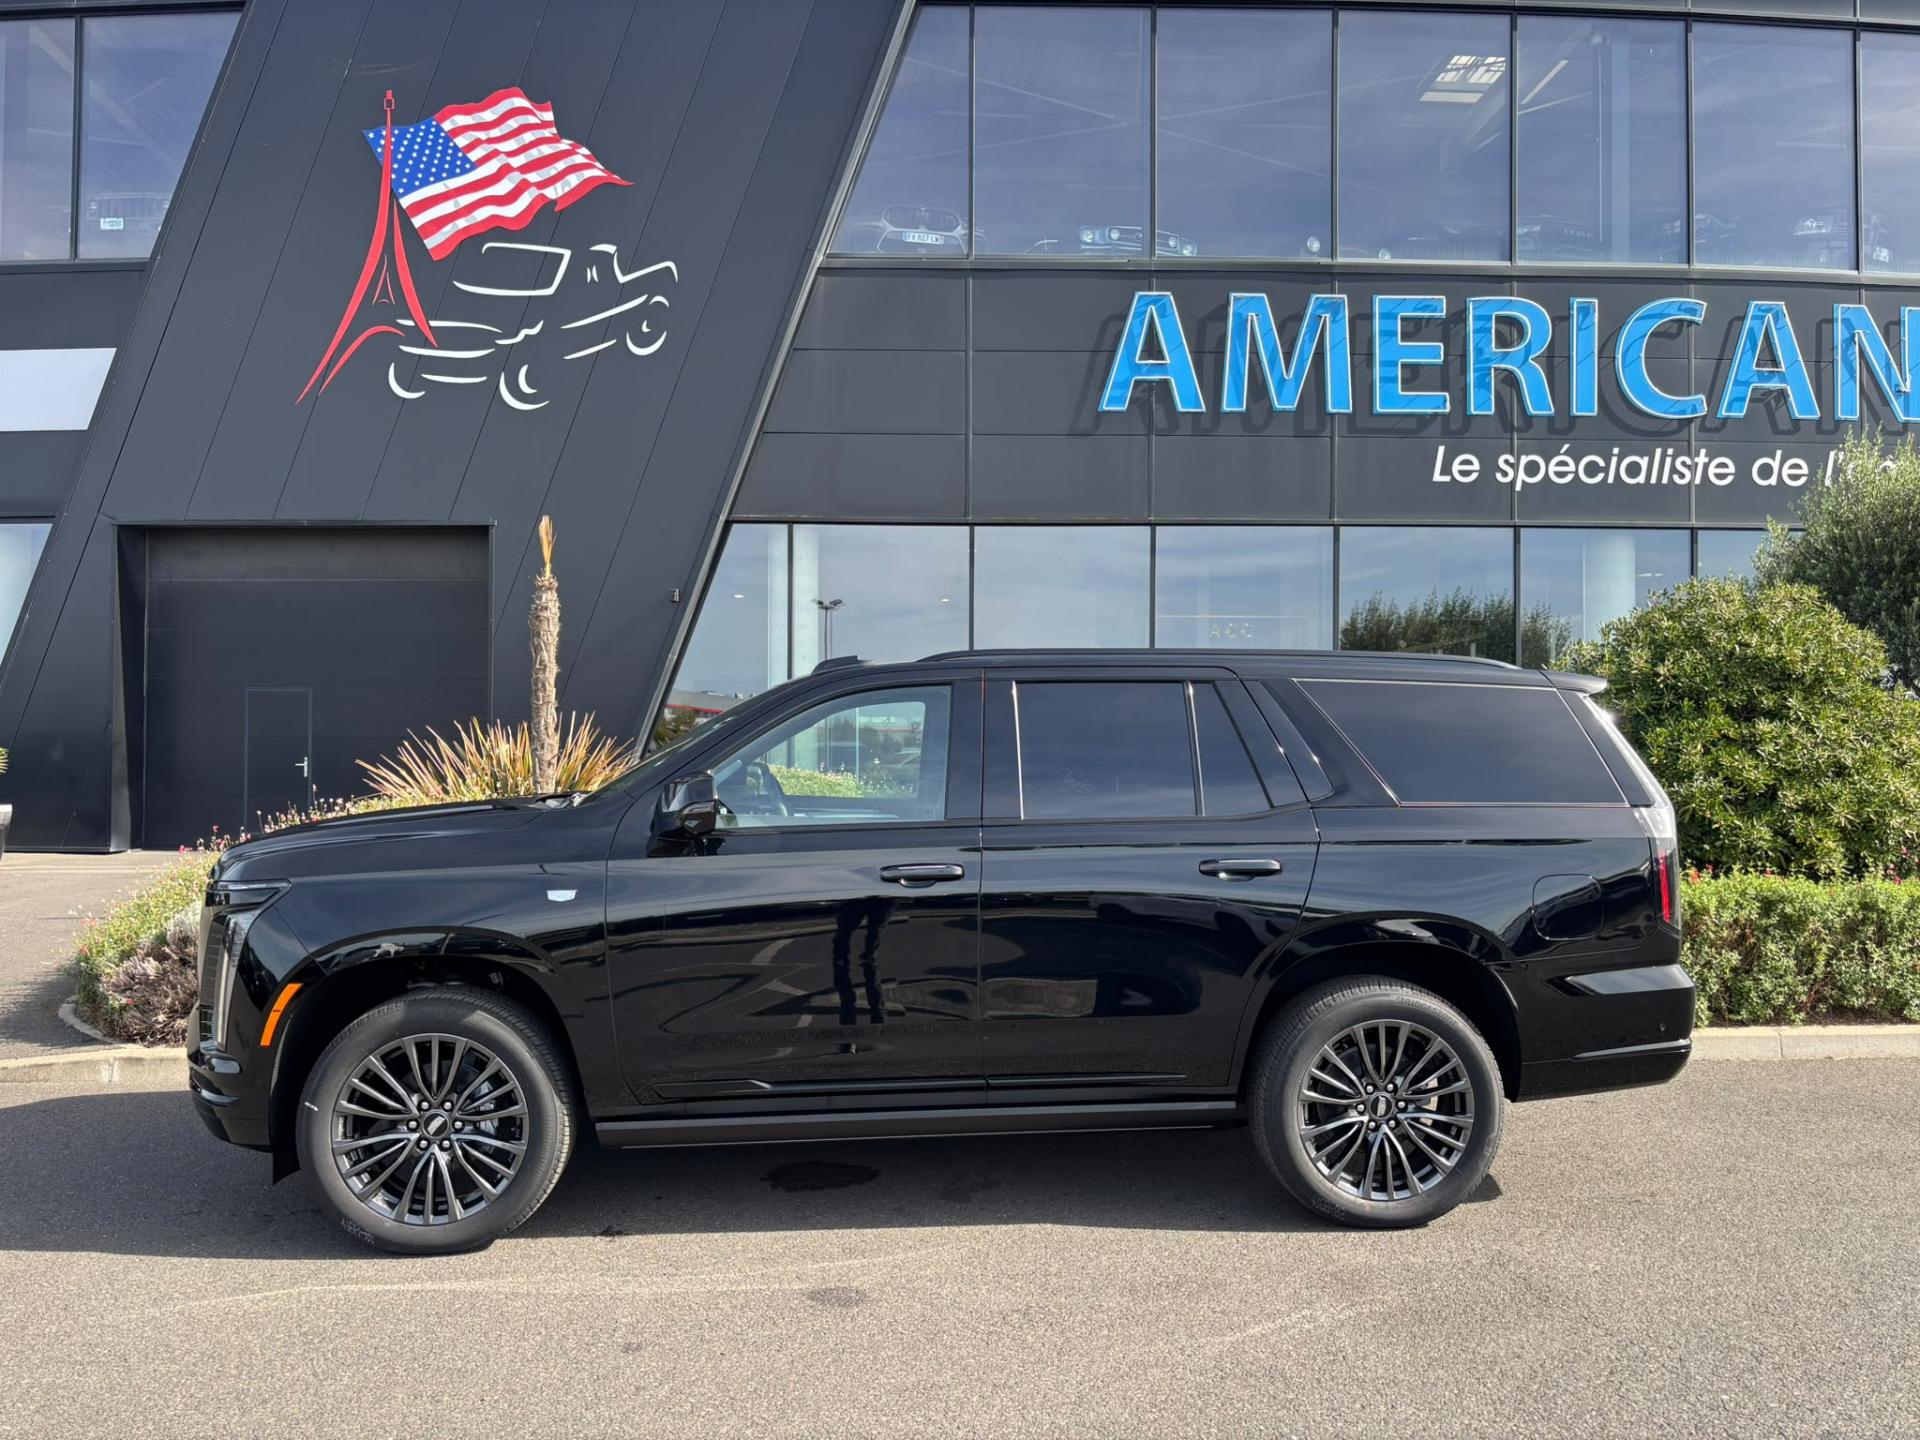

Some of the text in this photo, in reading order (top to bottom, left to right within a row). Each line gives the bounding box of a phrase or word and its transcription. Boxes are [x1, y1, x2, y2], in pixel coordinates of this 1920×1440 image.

[1097, 290, 1920, 422] AMERICAN
[1432, 445, 1481, 483] Le
[1495, 443, 1736, 492] spécialiste
[1751, 449, 1809, 487] de
